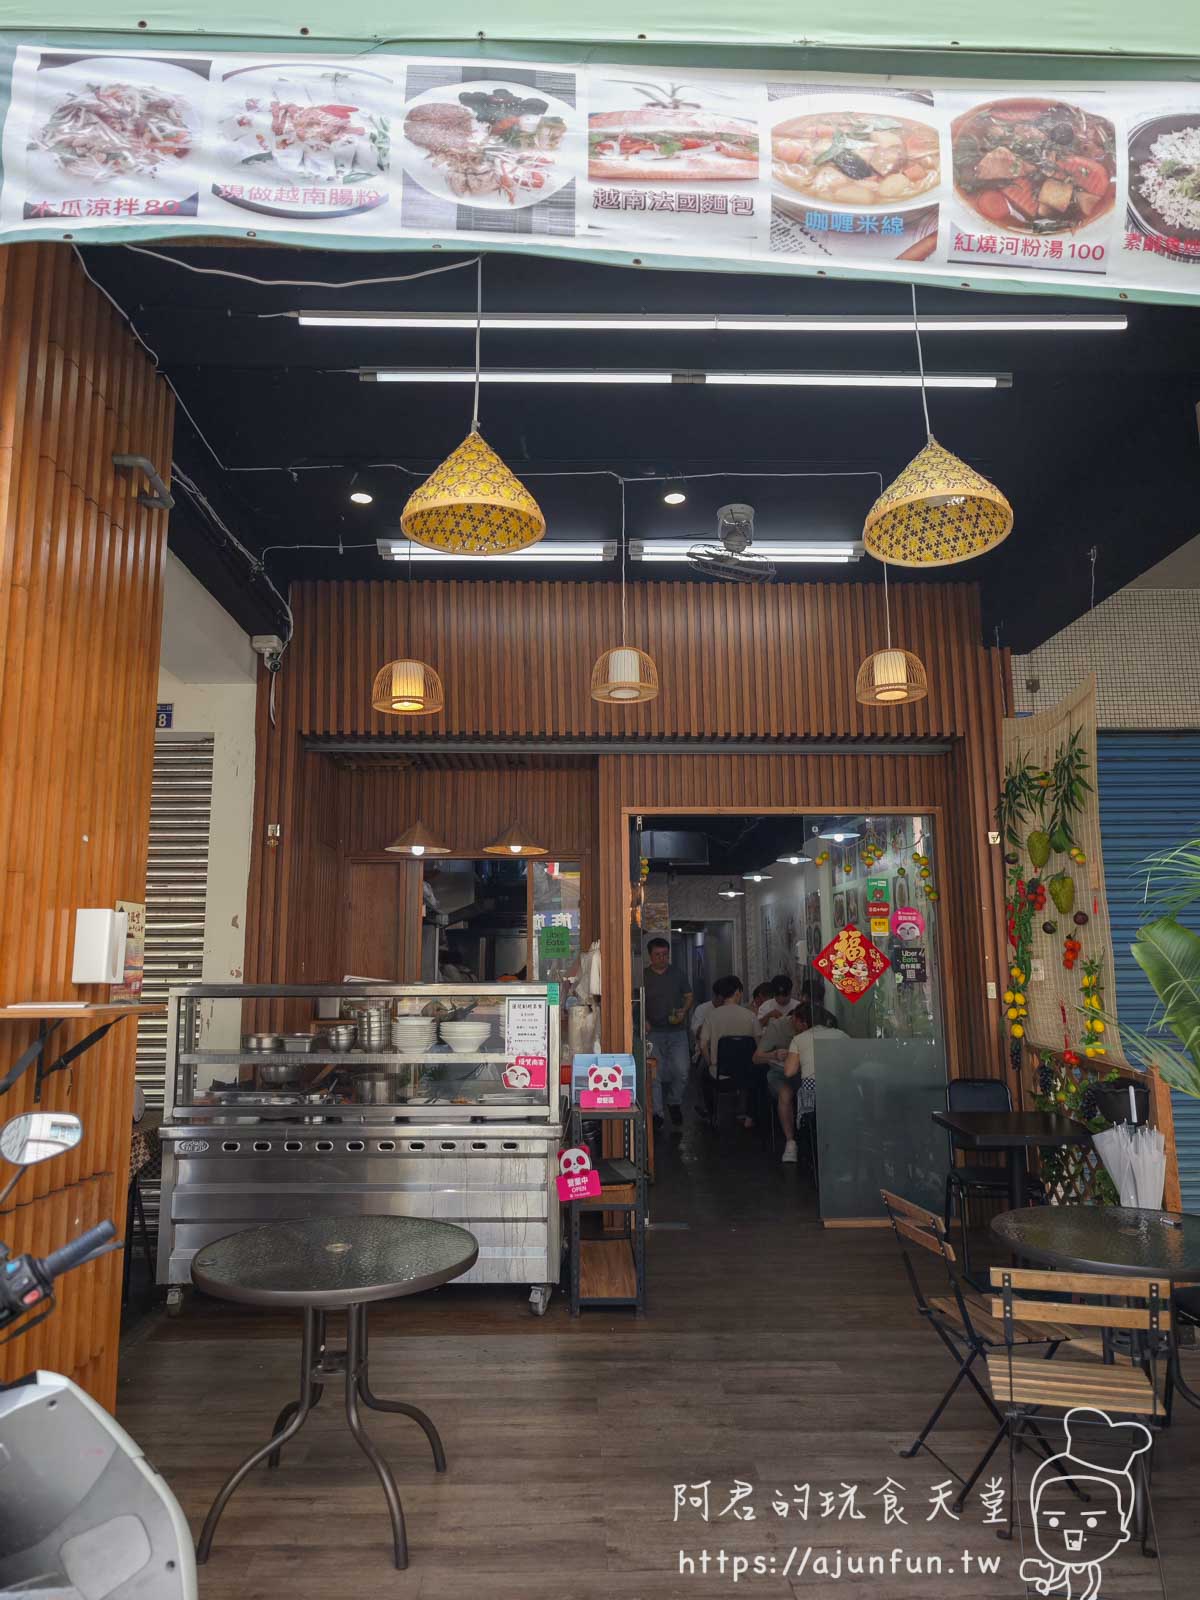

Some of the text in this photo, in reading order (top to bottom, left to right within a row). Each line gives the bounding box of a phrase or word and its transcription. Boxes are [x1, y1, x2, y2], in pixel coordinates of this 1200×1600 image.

[219, 184, 381, 208] 現做越南腸粉
[592, 188, 754, 217] 越南法國麵包
[954, 232, 1105, 261] 紅燒河粉湯100
[833, 930, 866, 962] 福
[571, 1185, 587, 1193] OPEN
